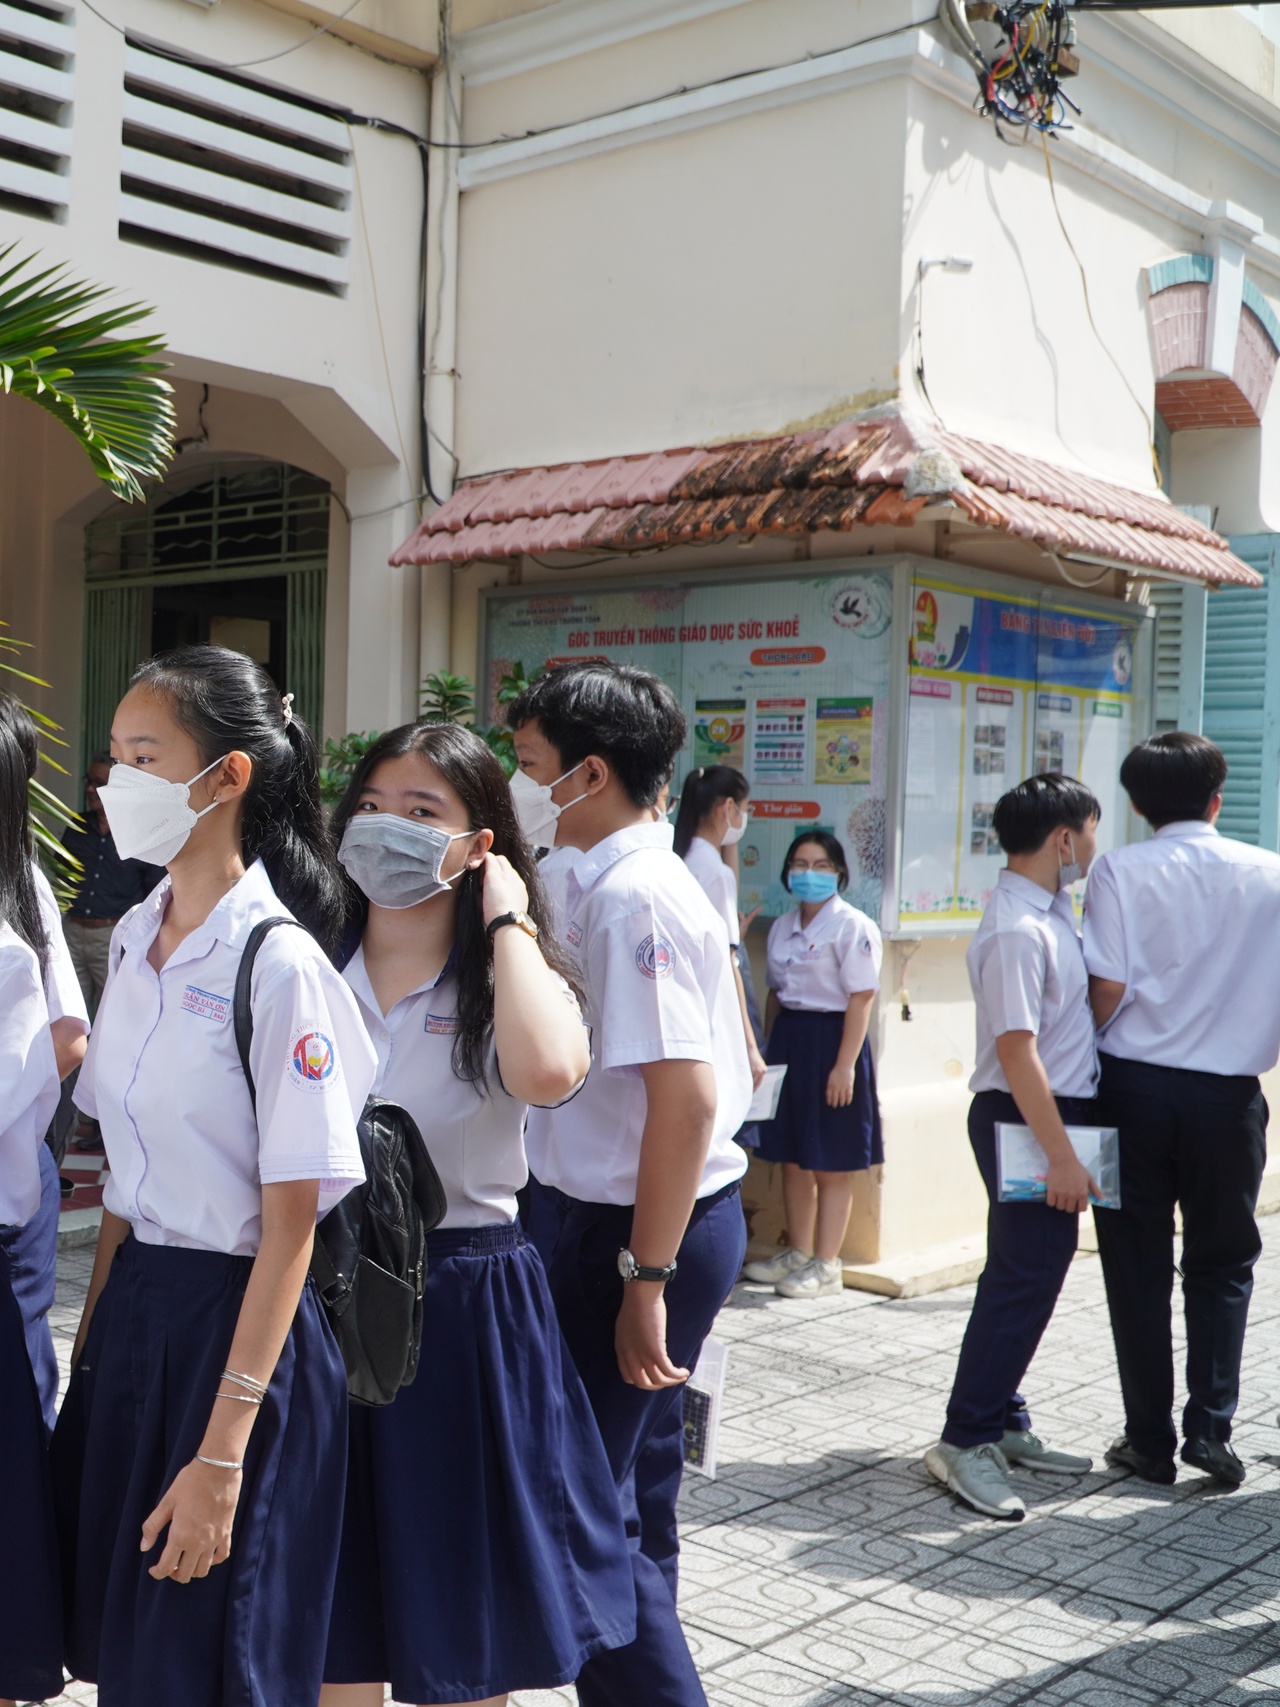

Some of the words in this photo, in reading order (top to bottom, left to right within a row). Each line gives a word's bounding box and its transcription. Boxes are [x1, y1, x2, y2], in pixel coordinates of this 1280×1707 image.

[567, 628, 590, 648] GÓC
[679, 621, 707, 643] GIÁO
[710, 623, 734, 645] DỤC
[738, 618, 763, 640] SỨC
[766, 613, 800, 639] KHOẺ
